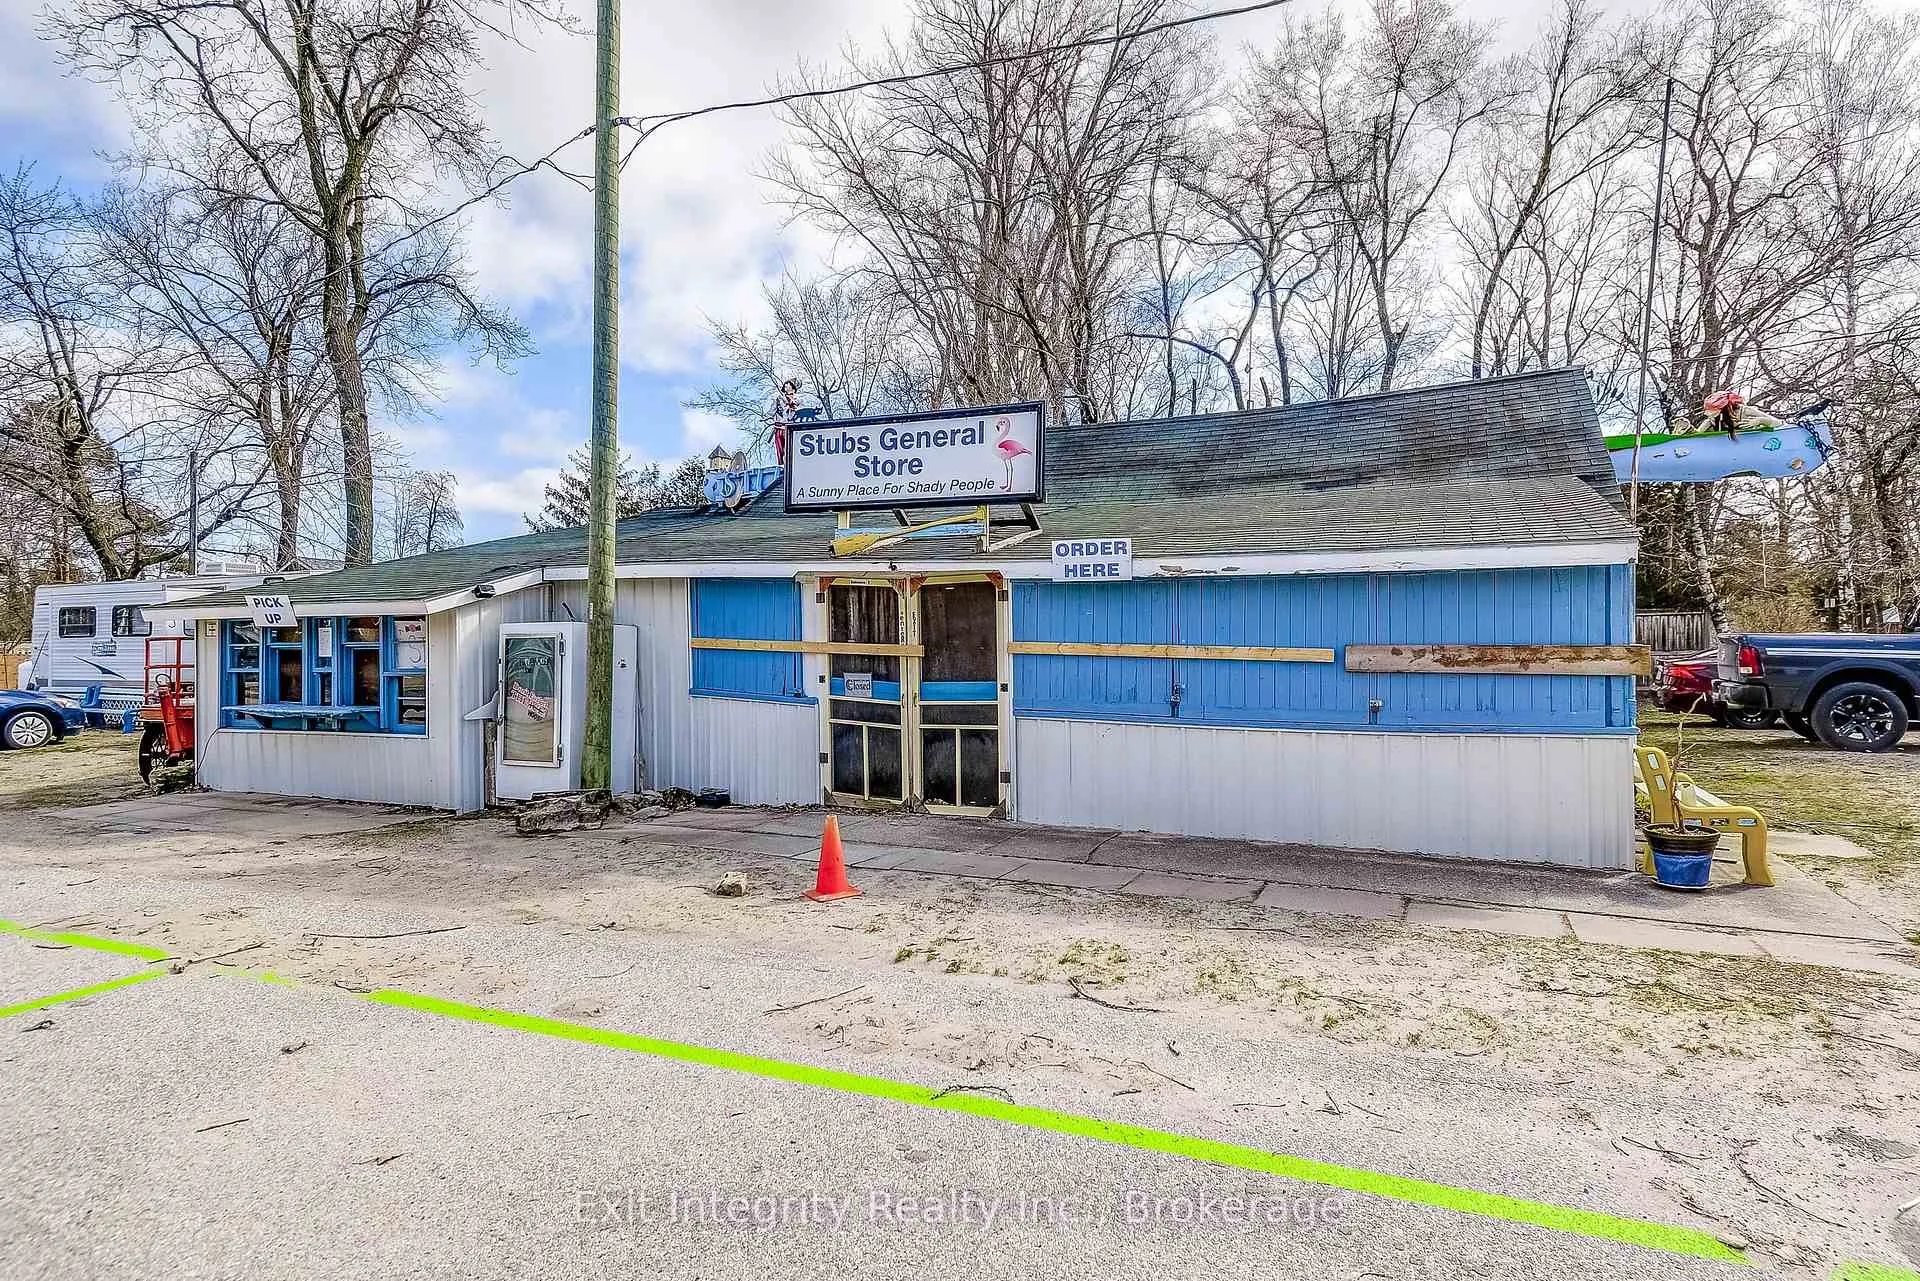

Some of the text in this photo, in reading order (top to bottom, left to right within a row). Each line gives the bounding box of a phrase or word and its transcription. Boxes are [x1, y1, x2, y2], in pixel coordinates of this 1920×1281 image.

[800, 421, 985, 456] Stubs General
[854, 455, 924, 478] Store
[796, 477, 995, 499] A Sunny Place For Shady People
[1055, 541, 1128, 557] ORDER
[1064, 563, 1120, 578] HERE
[253, 597, 284, 608] PICK
[264, 613, 282, 624] UP
